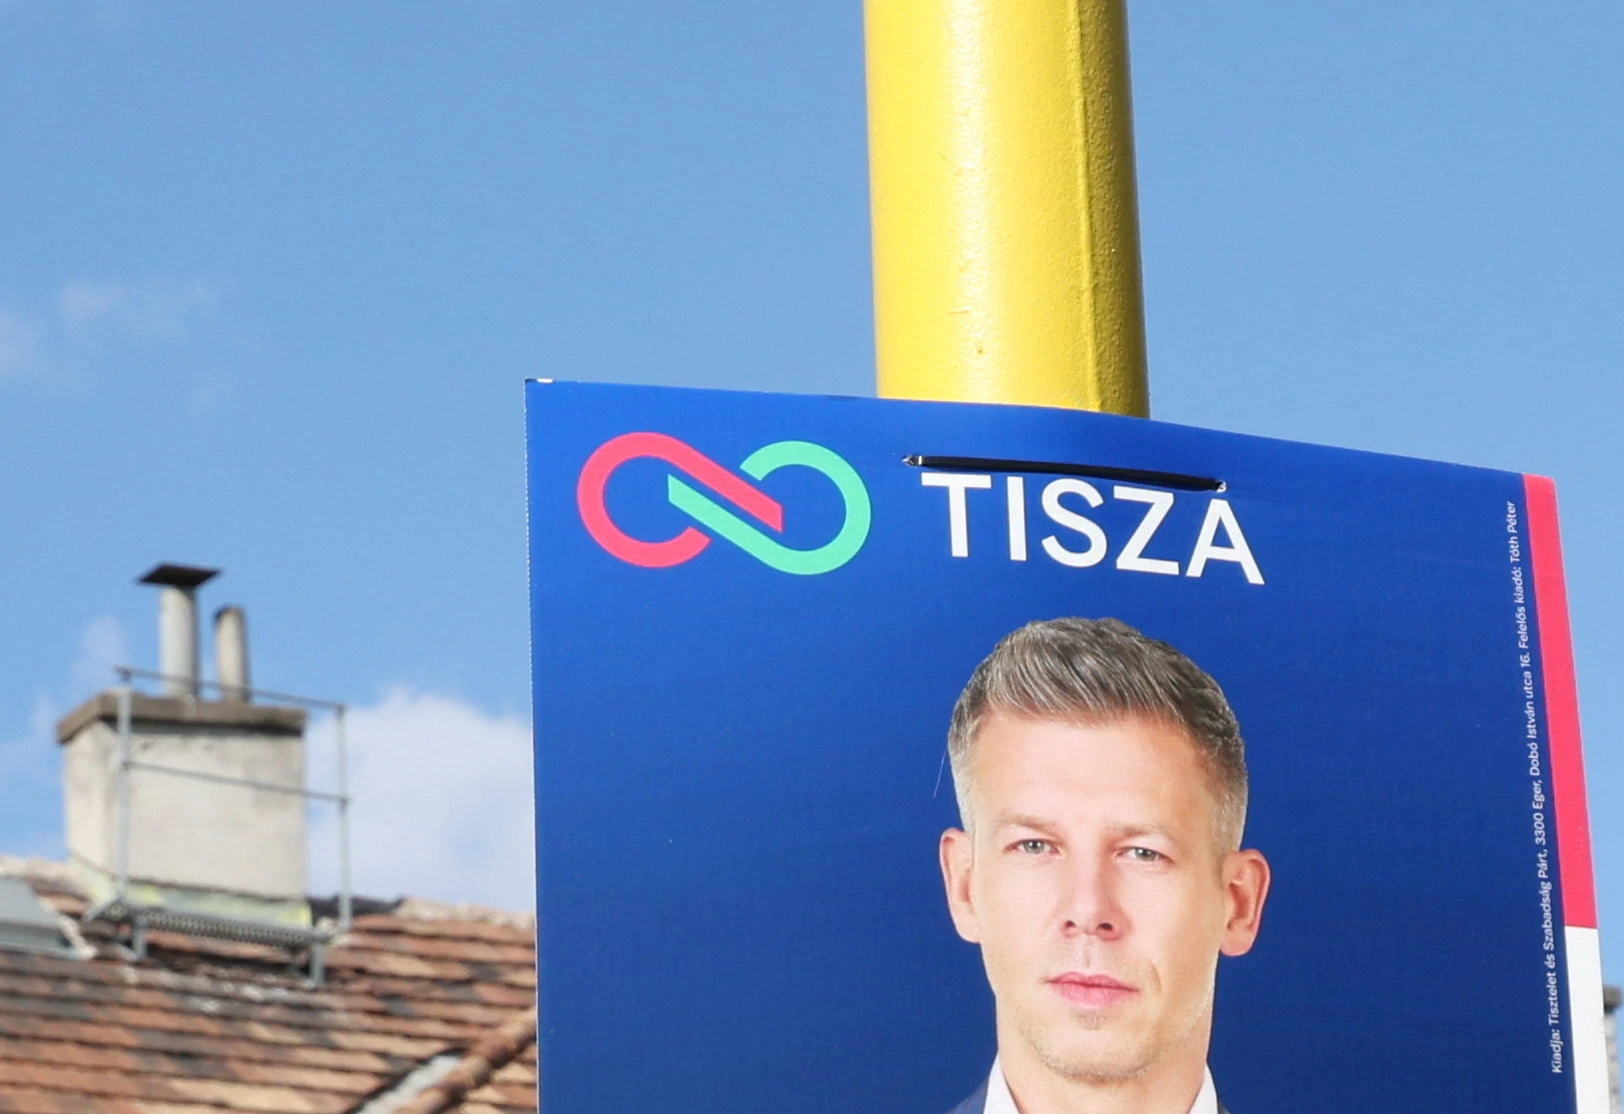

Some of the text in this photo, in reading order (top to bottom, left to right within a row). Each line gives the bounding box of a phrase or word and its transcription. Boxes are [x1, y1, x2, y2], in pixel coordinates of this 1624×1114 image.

[922, 473, 1264, 584] TISZA
[1506, 501, 1563, 1073] Kiadja: Tisztelet és Szabadság Párt, 3300 Eger, Dobó István utca 16. Felelős kiadó: Tóth Péter
